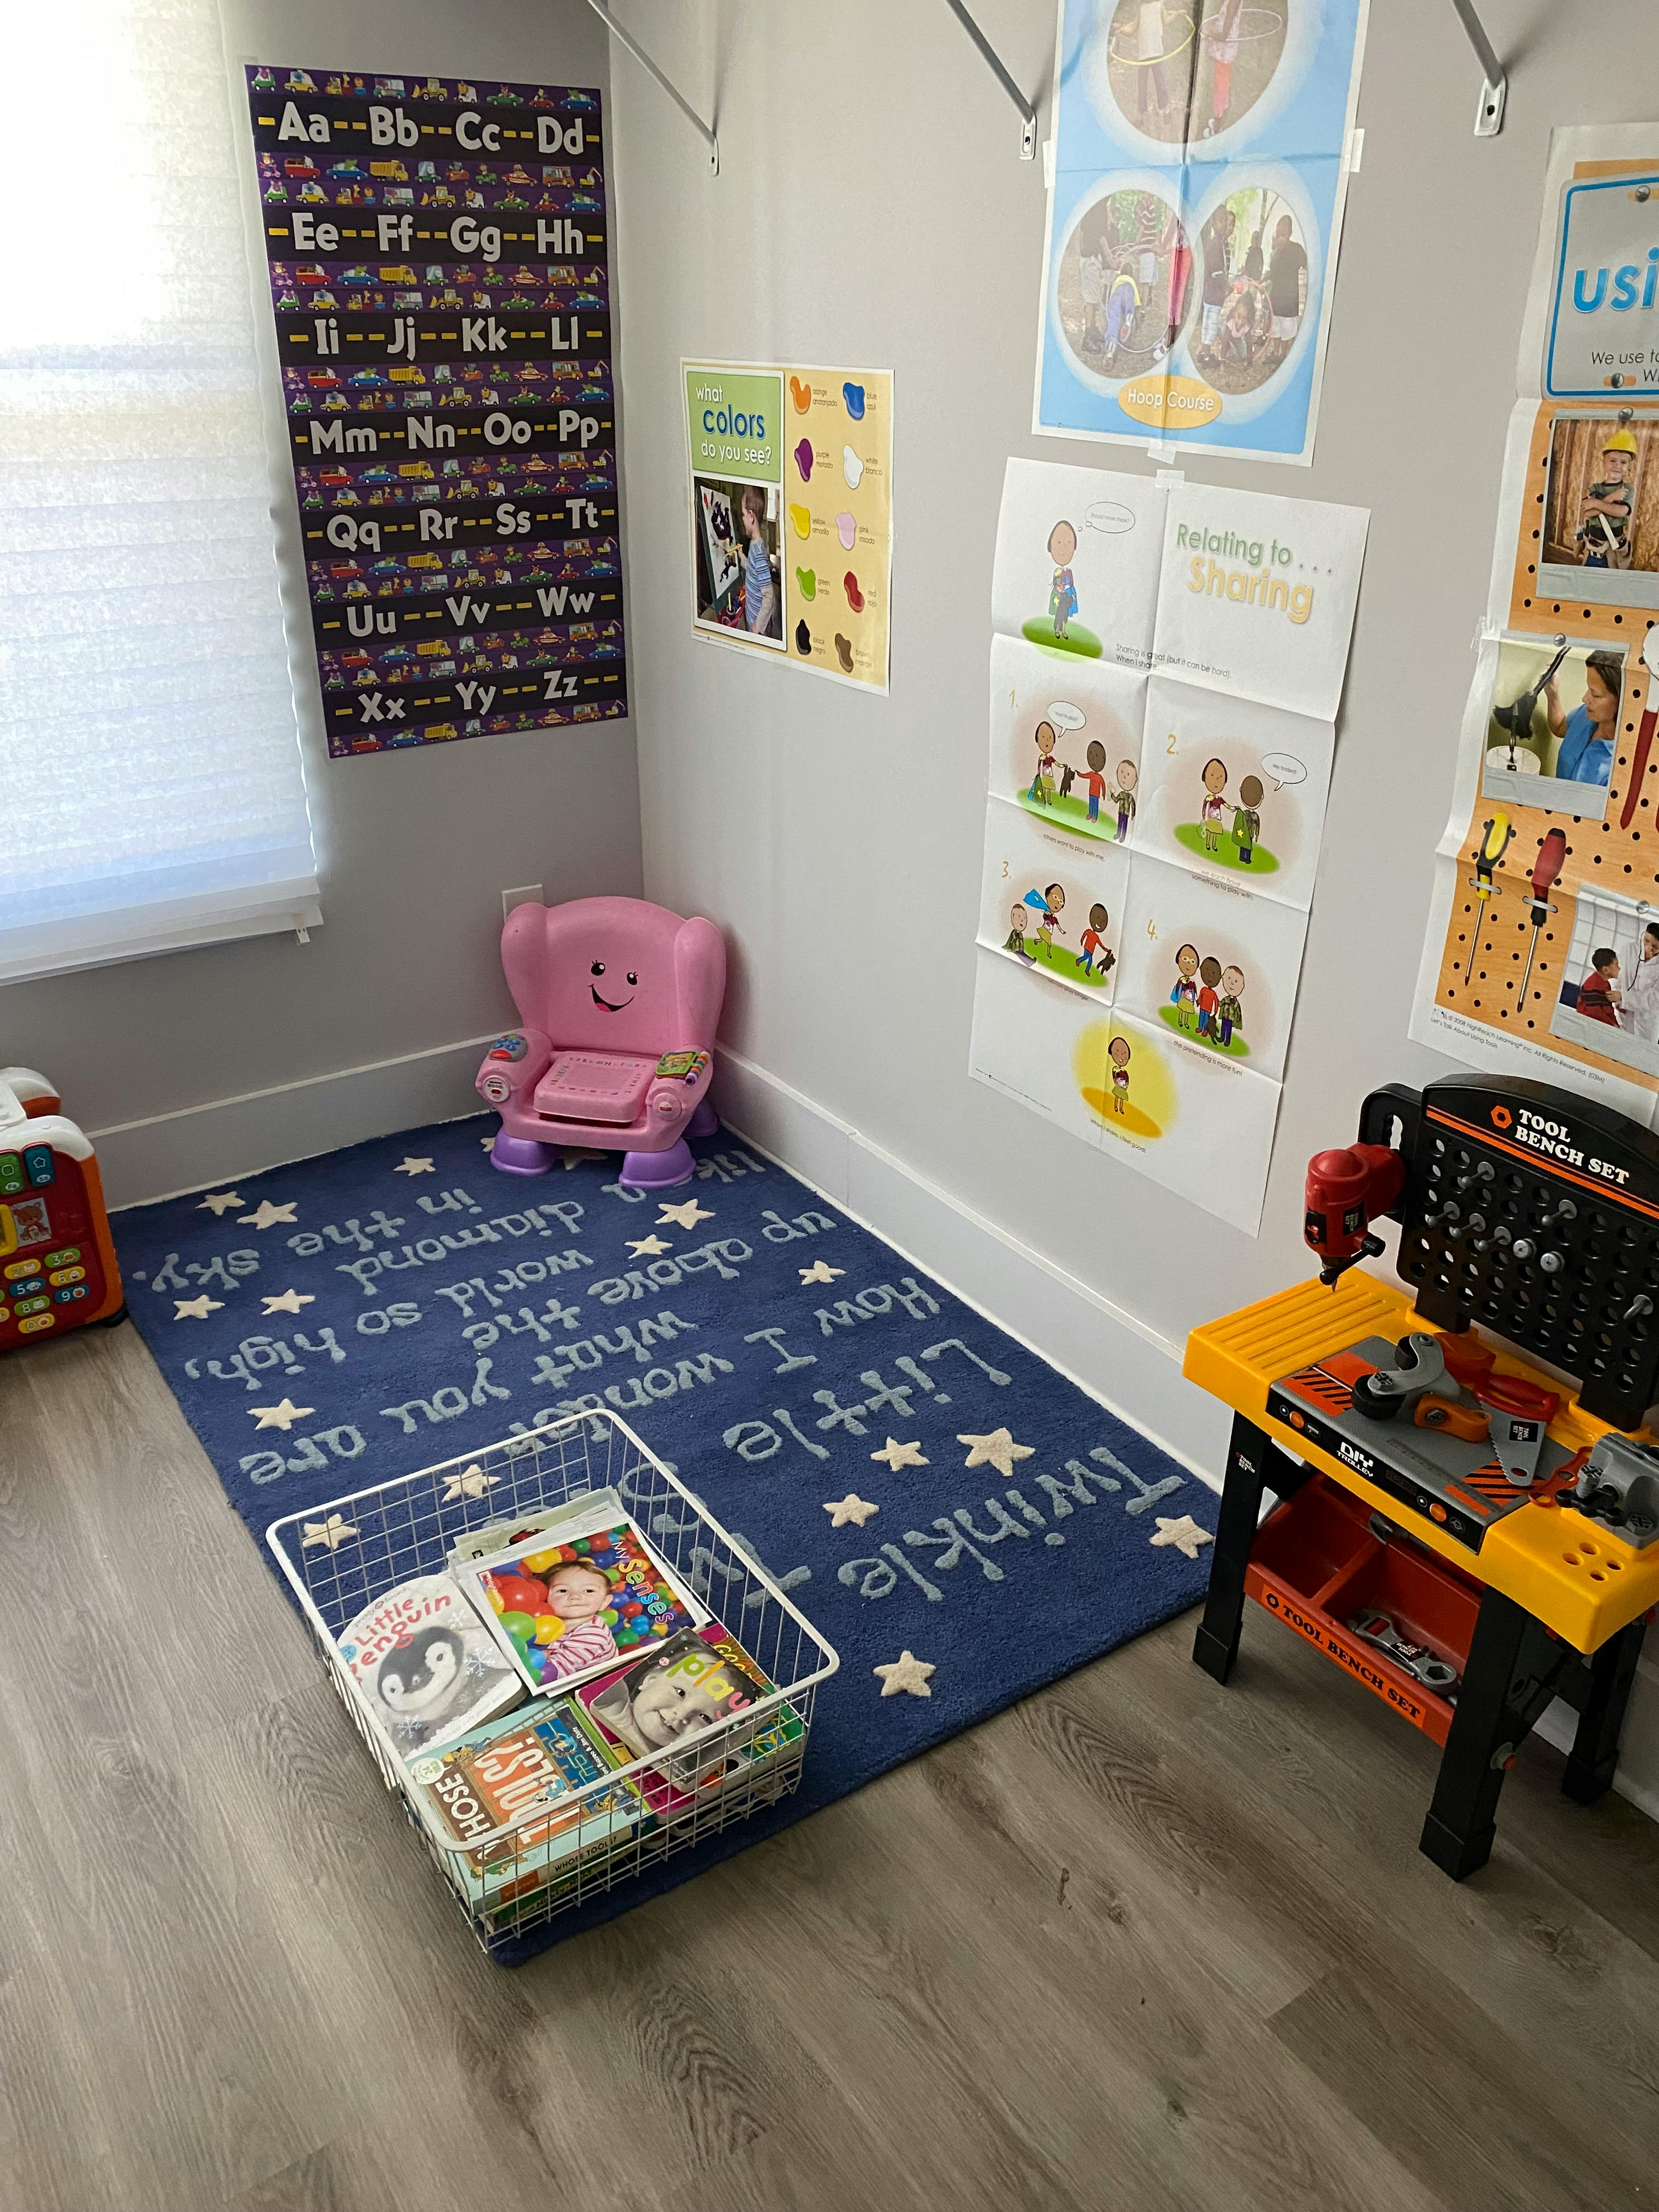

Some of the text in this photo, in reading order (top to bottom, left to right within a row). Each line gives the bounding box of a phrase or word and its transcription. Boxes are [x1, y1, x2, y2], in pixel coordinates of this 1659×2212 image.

[278, 101, 584, 155] Aa Bb Cc Dd
[292, 212, 583, 262] Ee Ff Gg Hh
[1572, 246, 1659, 313] usi
[314, 317, 578, 361] Ii Jj Kk Ll
[1592, 352, 1614, 364] We
[1620, 353, 1644, 364] use
[696, 383, 723, 403] what
[812, 388, 827, 397] orange
[1127, 388, 1215, 411] Hoop Course
[310, 410, 599, 454] Mm Nn Oo Pp
[703, 404, 766, 439] colors
[701, 439, 772, 465] do you see?
[816, 451, 830, 460] purple
[866, 466, 882, 476] blanco
[327, 499, 599, 552] Qq Rr Ss Tt
[860, 536, 875, 544] rosado
[1177, 523, 1293, 567] Relating to
[818, 579, 830, 587] green
[1187, 557, 1314, 624] Sharing
[346, 586, 595, 636] Uu Vv Ww
[1116, 644, 1139, 657] Sharing
[1147, 652, 1165, 661] great
[1167, 654, 1180, 664] (but
[1201, 664, 1210, 673] be
[1116, 654, 1134, 664] When
[358, 670, 578, 723] Xx Yy Zz
[1166, 733, 1178, 755] 2.
[1001, 861, 1011, 879] 3.
[1148, 919, 1158, 940] 4.
[1454, 1028, 1469, 1036] About
[1470, 1033, 1484, 1043] Using
[1466, 1023, 1496, 1038] HighReach
[1542, 1053, 1558, 1064] Rights
[1183, 1046, 1211, 1063] pretending
[1217, 1062, 1231, 1071] more
[1519, 1109, 1571, 1143] TOOL
[1515, 1125, 1629, 1184] BENCH SET
[131, 1188, 483, 1293] in the sky.
[334, 1200, 585, 1296] diamond
[13, 1267, 20, 1277] 2
[53, 1255, 60, 1266] 3
[17, 1285, 26, 1295] 5
[58, 1273, 66, 1283] 6
[461, 1209, 838, 1350] up above the
[22, 1304, 31, 1313] 8
[61, 1291, 70, 1301] 9
[27, 1321, 36, 1330] 0
[183, 1249, 595, 1391] world so high,
[505, 1277, 941, 1458] How I wonder
[238, 1310, 699, 1486] what you are
[720, 1337, 1013, 1462] Little
[1239, 1458, 1255, 1474] BENCH
[1240, 1454, 1252, 1467] TOOL
[1336, 1451, 1373, 1477] TROLLEY
[1340, 1442, 1373, 1468] DIY
[837, 1445, 1187, 1604] Twinkle
[612, 1541, 630, 1558] My
[618, 1559, 674, 1624] Senses
[355, 1599, 414, 1646] Little
[1283, 1605, 1421, 1719] TOOL BENCH SET
[666, 1653, 751, 1720] play
[590, 1751, 603, 1767] Buzzeo
[555, 1854, 584, 1872] WHOSE
